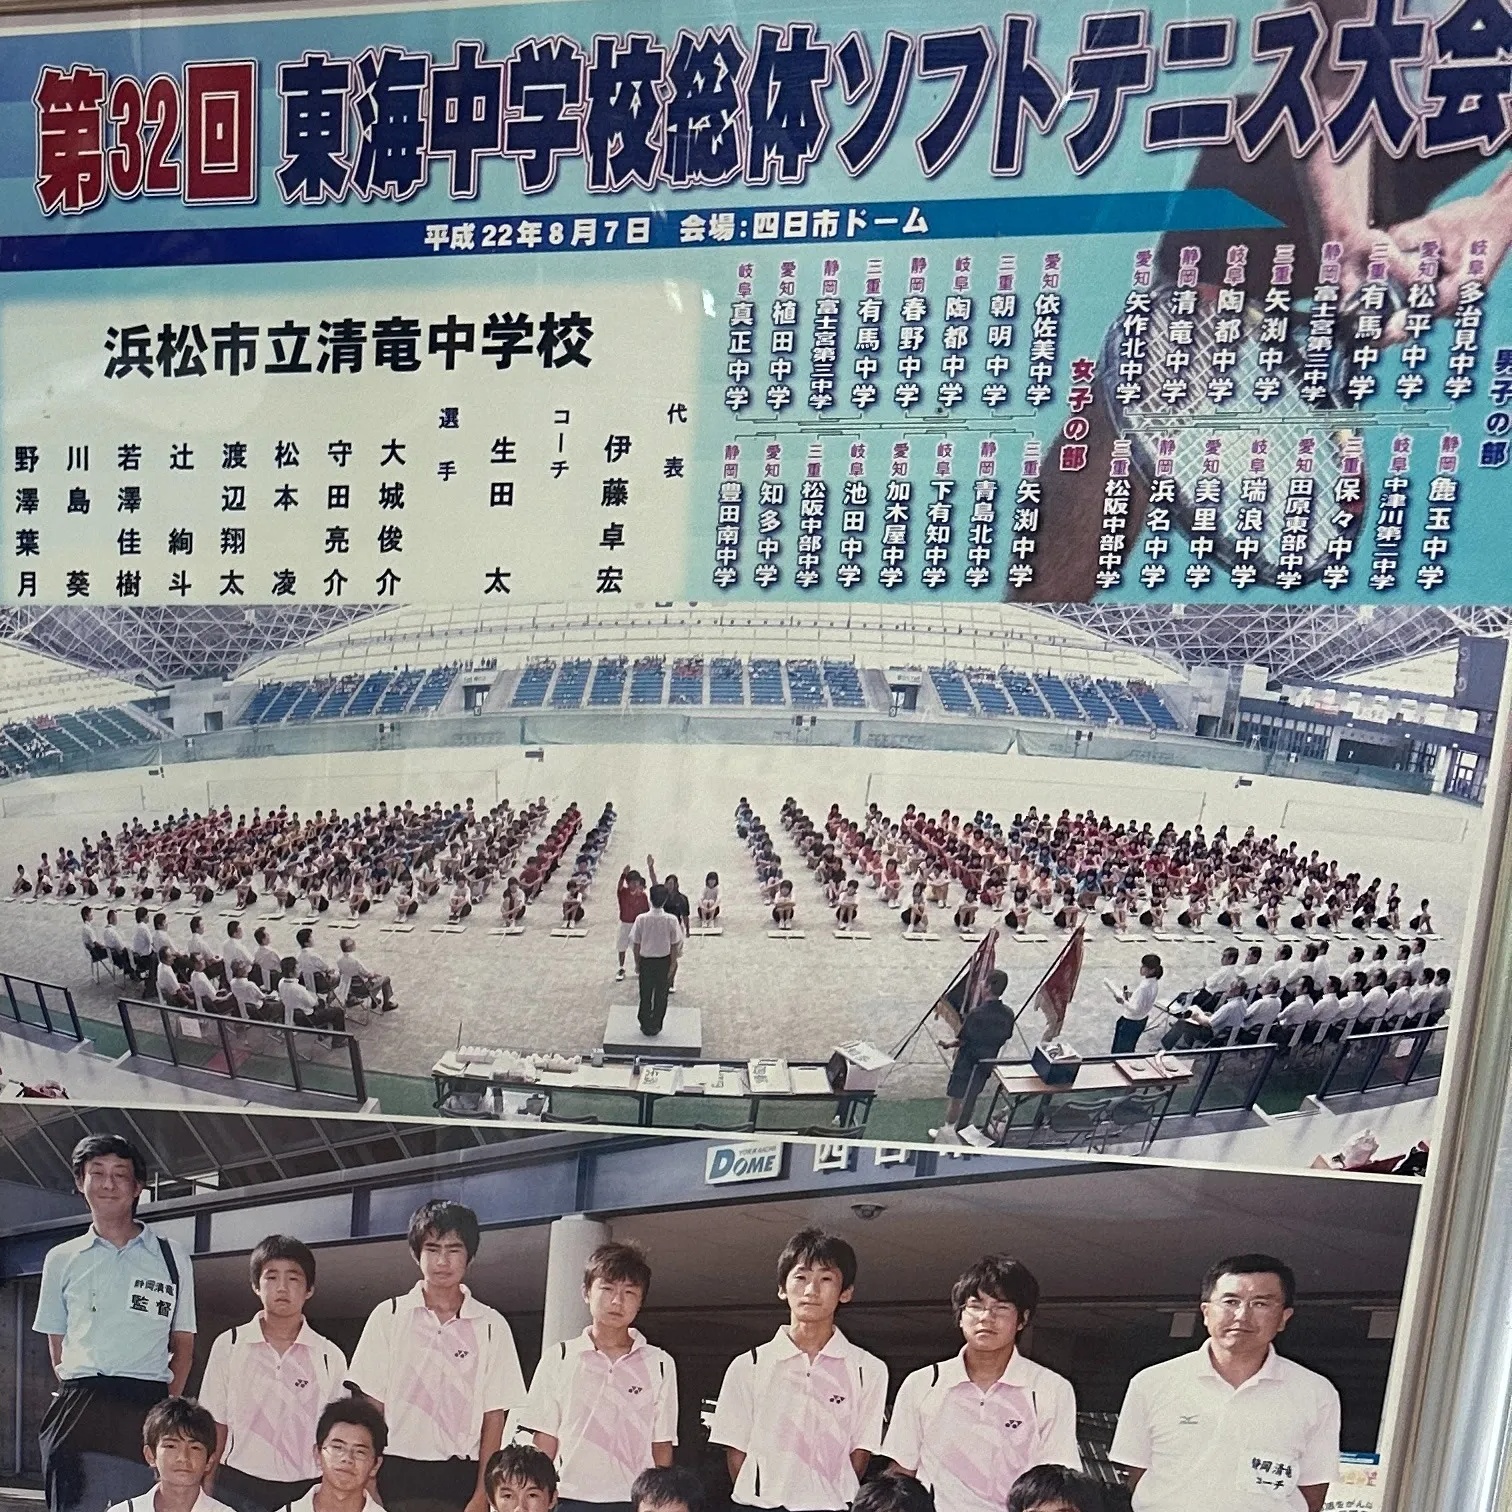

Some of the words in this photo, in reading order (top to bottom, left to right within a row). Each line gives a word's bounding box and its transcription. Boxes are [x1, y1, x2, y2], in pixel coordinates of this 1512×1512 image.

[34, 58, 259, 215] 第32回
[276, 0, 1512, 206] 東海中学校総体ソフトテニス大会
[103, 312, 594, 381] 浜松市立清竜中学校
[438, 407, 460, 481] 選手
[1060, 358, 1095, 472] 女子の部
[219, 441, 247, 596] 渡辺翔太
[324, 439, 352, 596] 守田亮介
[376, 438, 406, 596] 大城俊介
[709, 1149, 776, 1179] DOME
